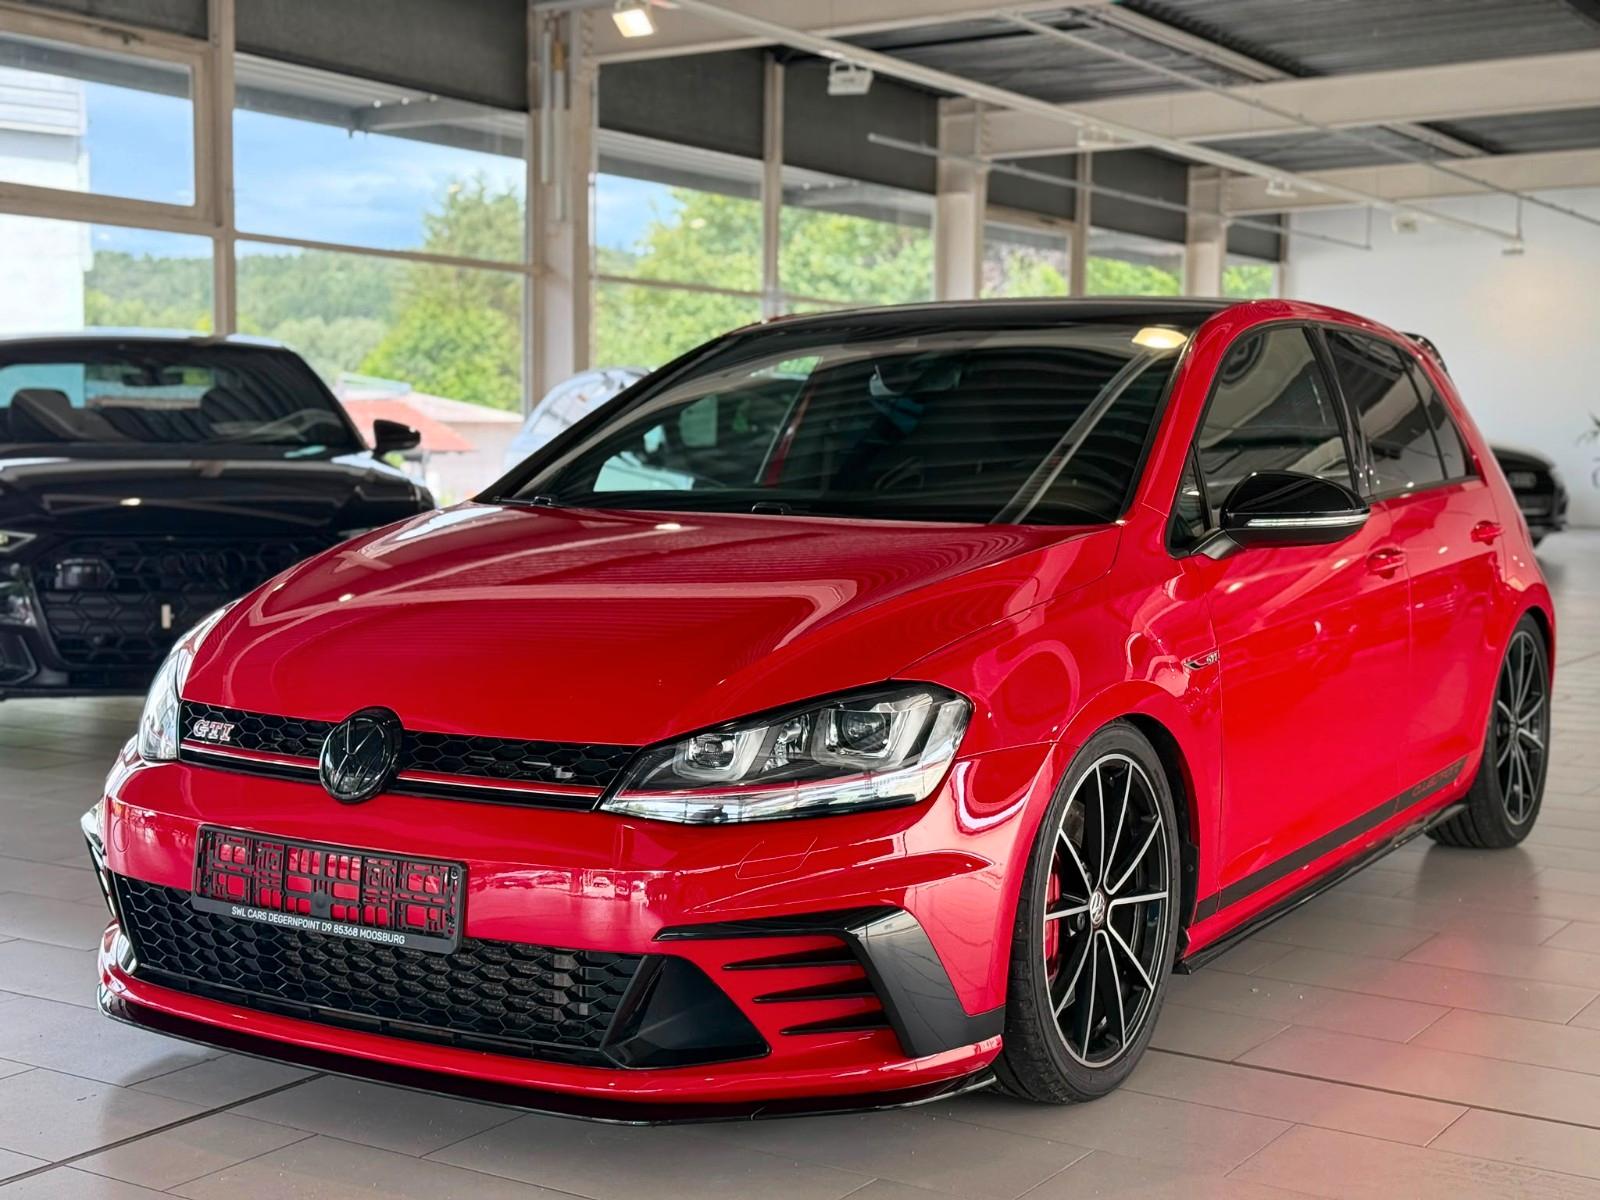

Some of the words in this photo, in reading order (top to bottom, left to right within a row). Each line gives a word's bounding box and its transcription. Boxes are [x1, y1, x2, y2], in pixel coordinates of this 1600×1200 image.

[193, 719, 235, 741] GTI
[231, 906, 247, 917] SWL
[247, 909, 267, 921] CARS
[268, 912, 321, 930] DEGERNPOINT
[321, 922, 332, 932] D9
[333, 924, 358, 937] 85368
[360, 928, 405, 944] MOOSBURG
